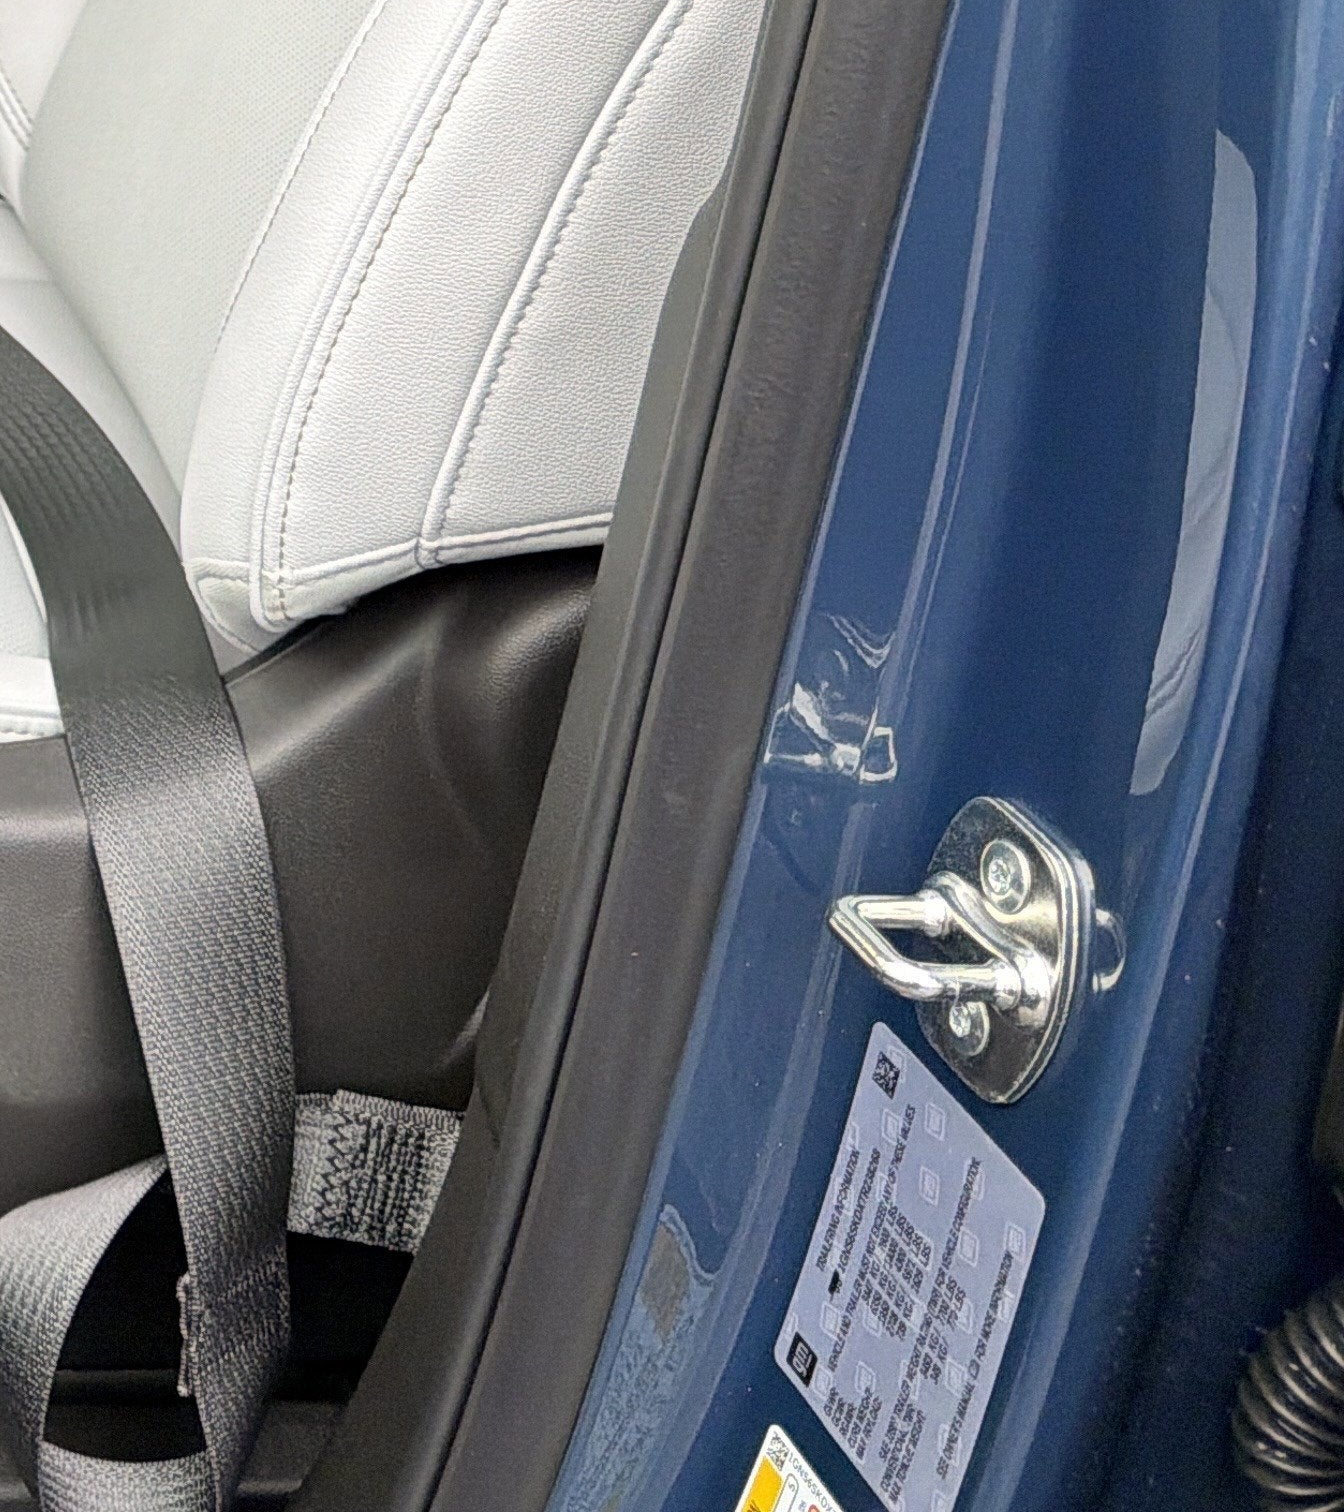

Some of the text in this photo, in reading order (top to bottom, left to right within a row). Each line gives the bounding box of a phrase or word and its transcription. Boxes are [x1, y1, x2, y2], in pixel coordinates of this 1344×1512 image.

[816, 1146, 859, 1270] TRAILERING INFORMATION
[845, 1279, 861, 1316] TRAILER
[793, 1343, 810, 1374] gm
